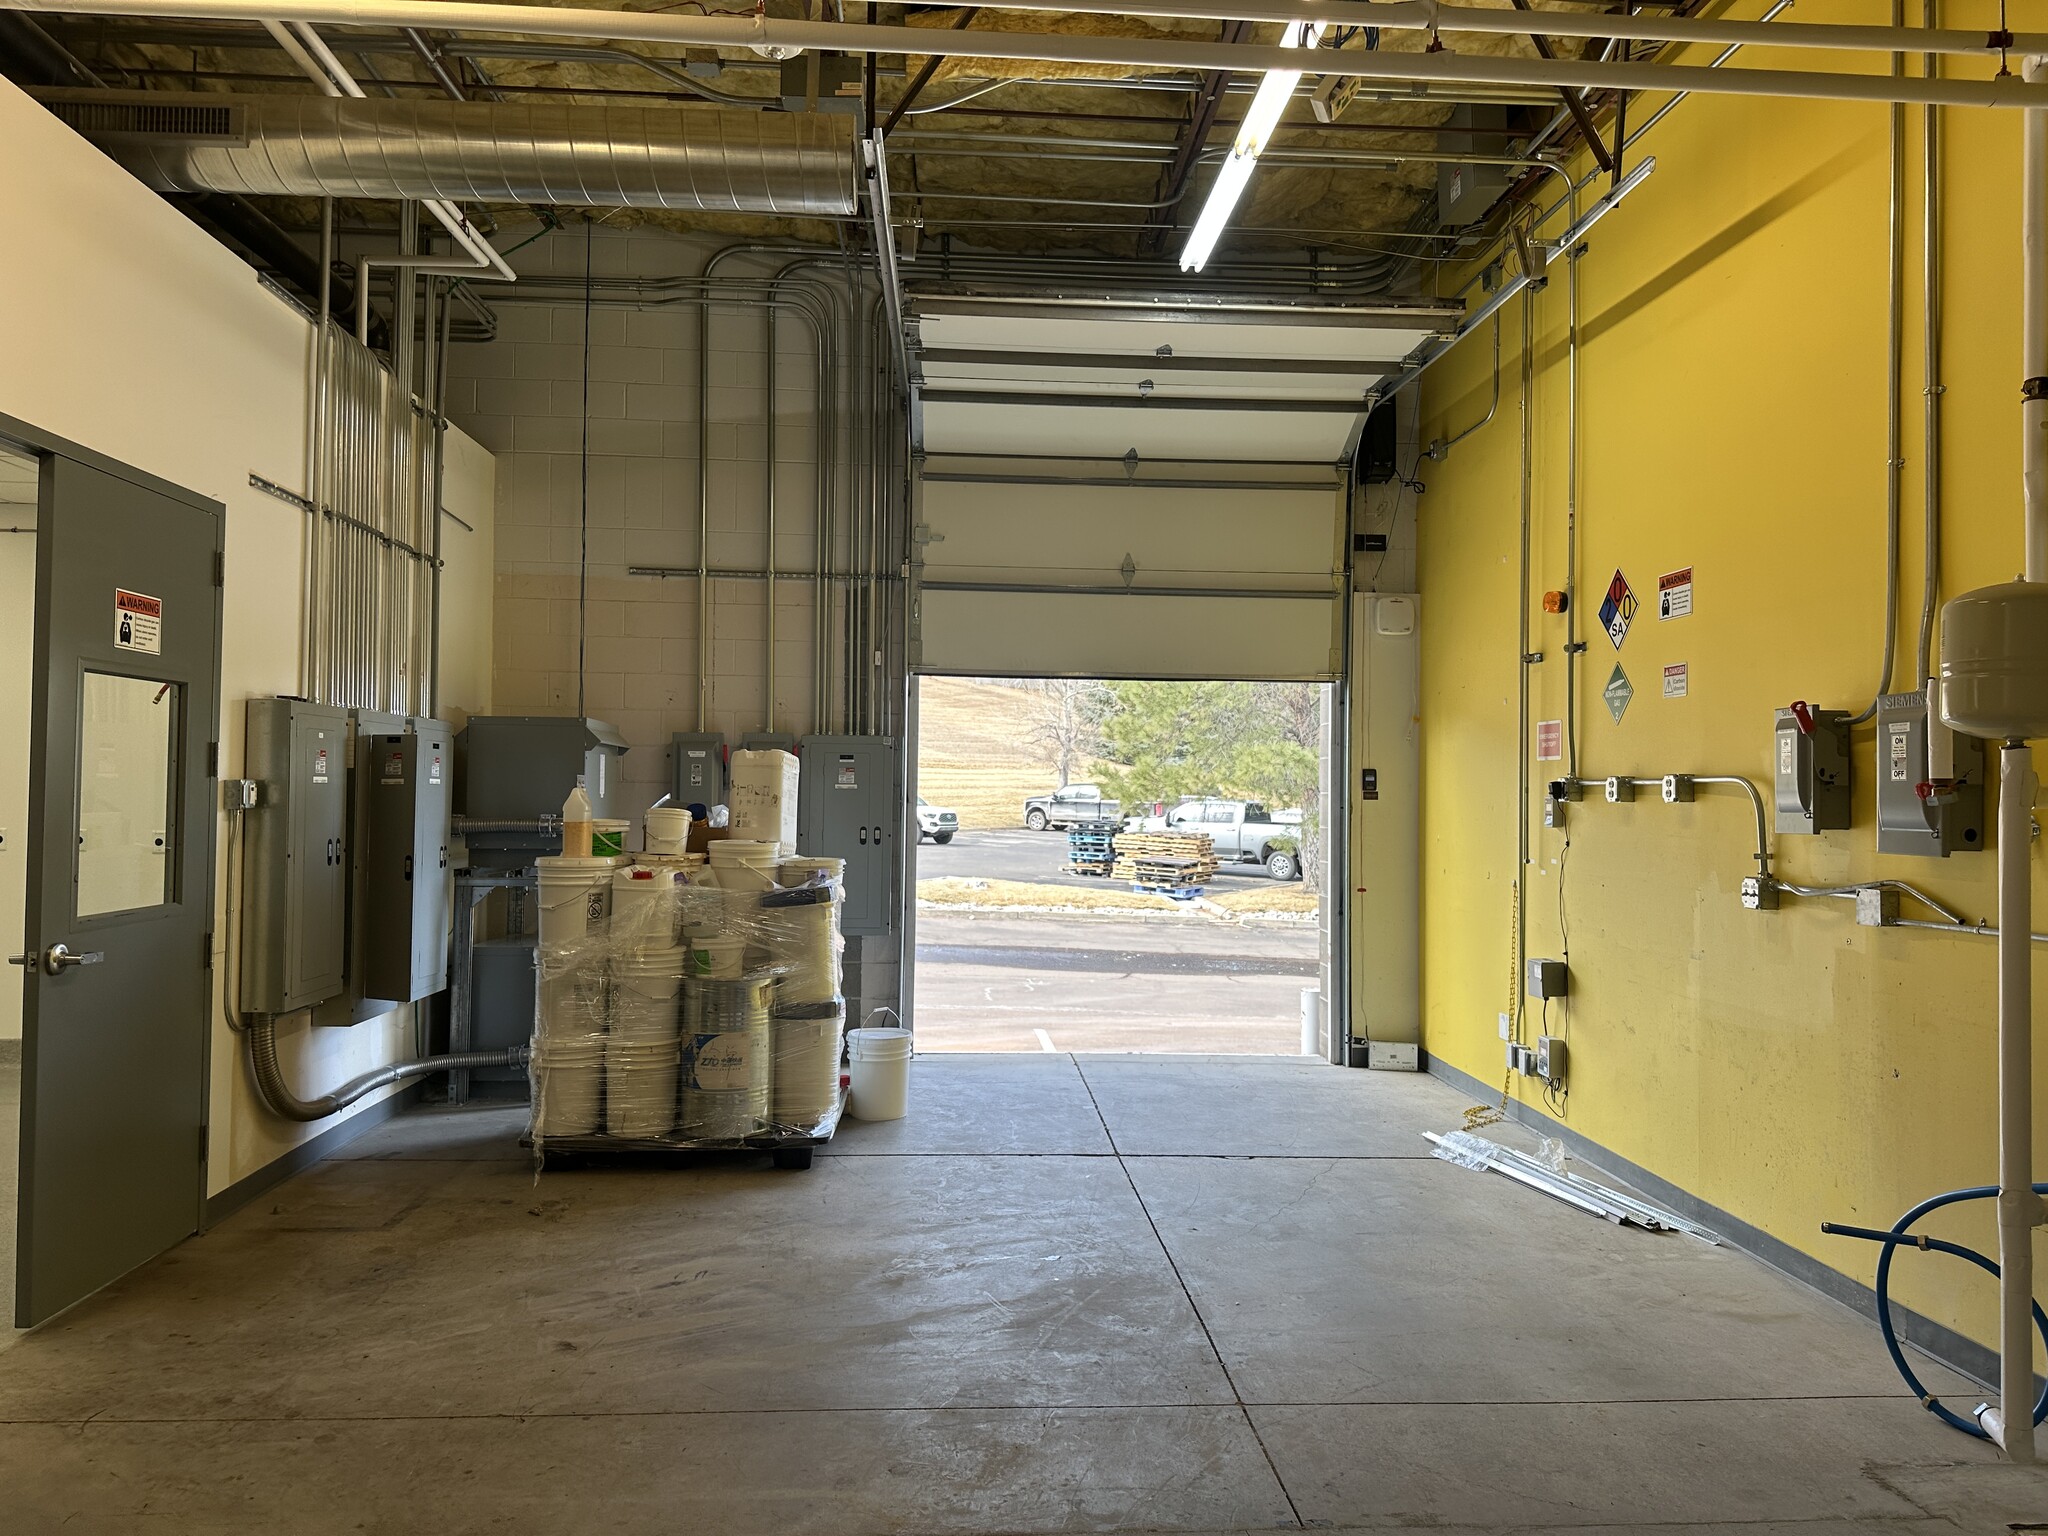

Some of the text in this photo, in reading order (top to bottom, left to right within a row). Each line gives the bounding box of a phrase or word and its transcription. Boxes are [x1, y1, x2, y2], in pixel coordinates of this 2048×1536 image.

[1666, 571, 1691, 586] WARNING
[1614, 577, 1622, 602] 0
[127, 596, 159, 614] WARNING
[1605, 599, 1612, 623] 2
[1623, 594, 1631, 620] 0
[1612, 622, 1623, 637] SA
[1669, 665, 1685, 675] DANGER
[1894, 770, 1904, 778] OFF
